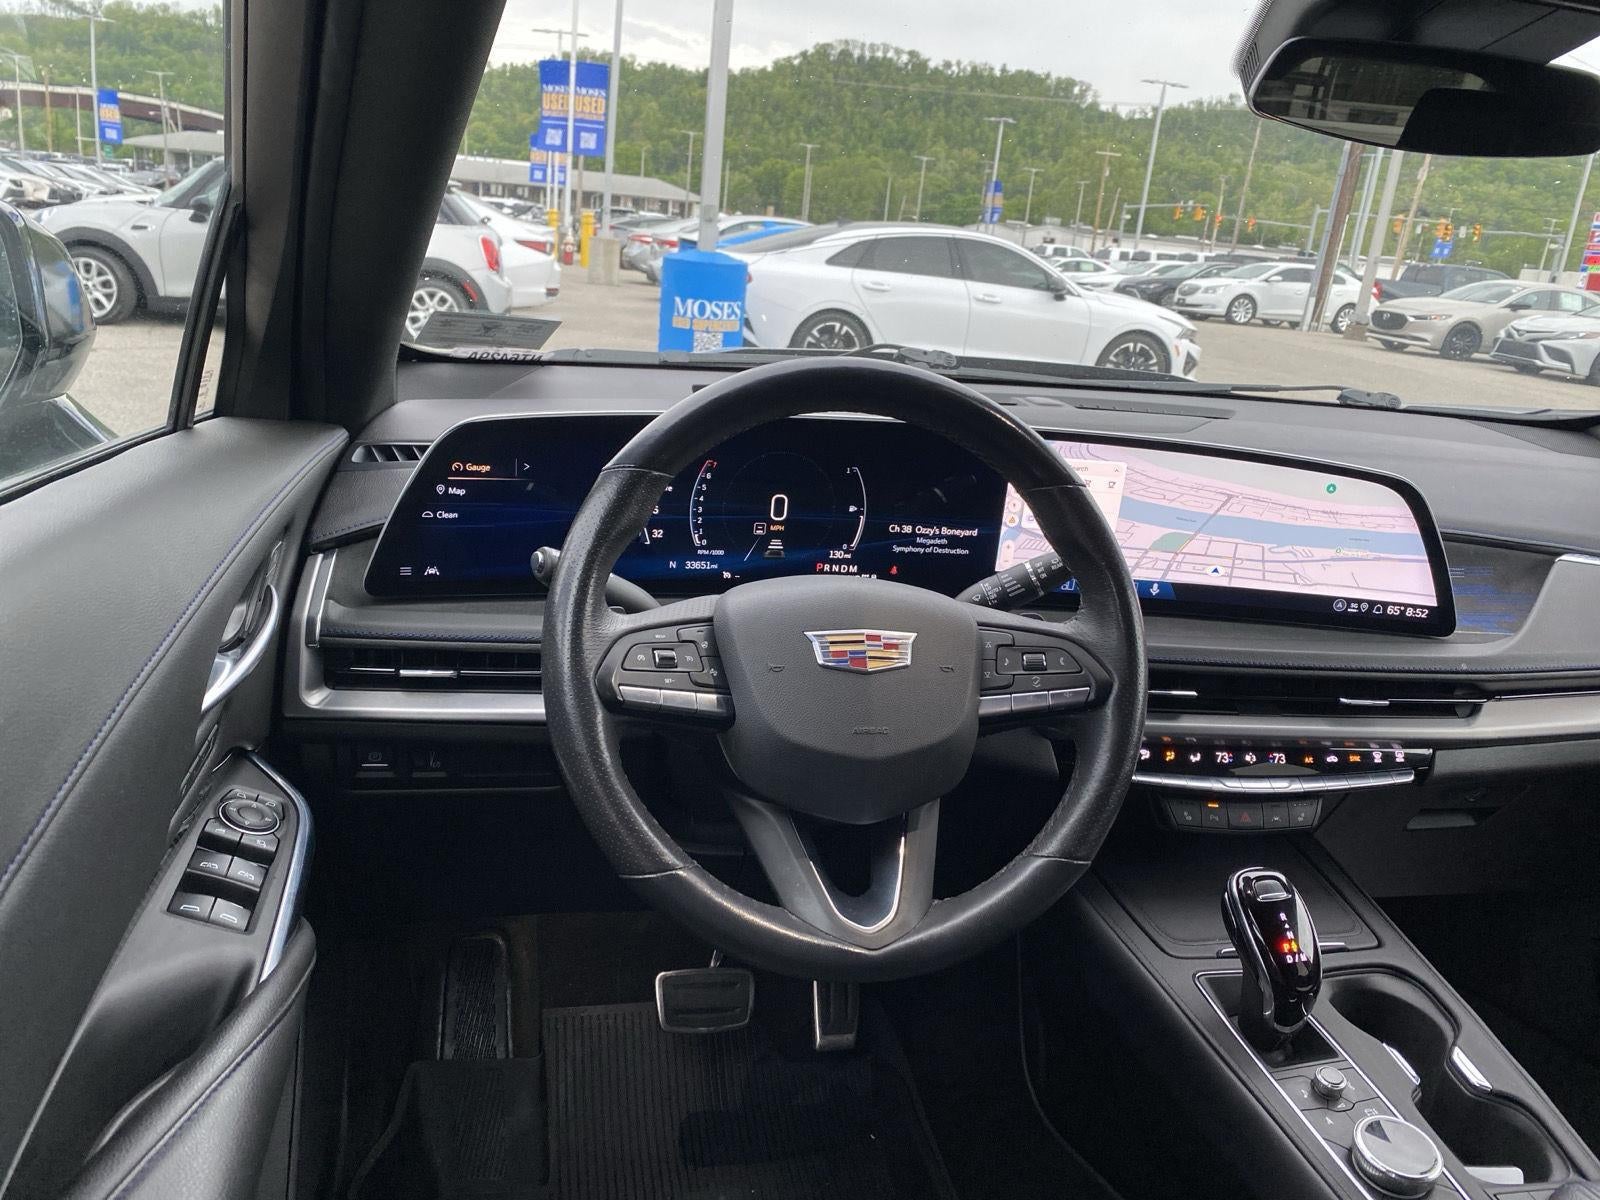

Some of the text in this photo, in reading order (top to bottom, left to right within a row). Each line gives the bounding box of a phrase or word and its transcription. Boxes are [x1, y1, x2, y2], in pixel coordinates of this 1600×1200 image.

[575, 95, 605, 114] USED
[674, 296, 742, 321] MOSES
[466, 463, 491, 473] Gauge
[448, 487, 466, 496] Map
[770, 494, 788, 520] 0
[436, 511, 458, 519] Clean
[770, 524, 784, 532] MPH
[888, 524, 978, 538] Ch 38 Ozzy's Boneyard
[652, 529, 663, 538] 32
[916, 537, 948, 546] Megadeth
[892, 545, 924, 554] Symphony
[933, 546, 970, 555] Destruction
[669, 561, 676, 569] N
[1405, 607, 1429, 618] 8:52
[1216, 752, 1229, 764] 73
[1274, 753, 1286, 764] 73
[1280, 912, 1288, 921] R
